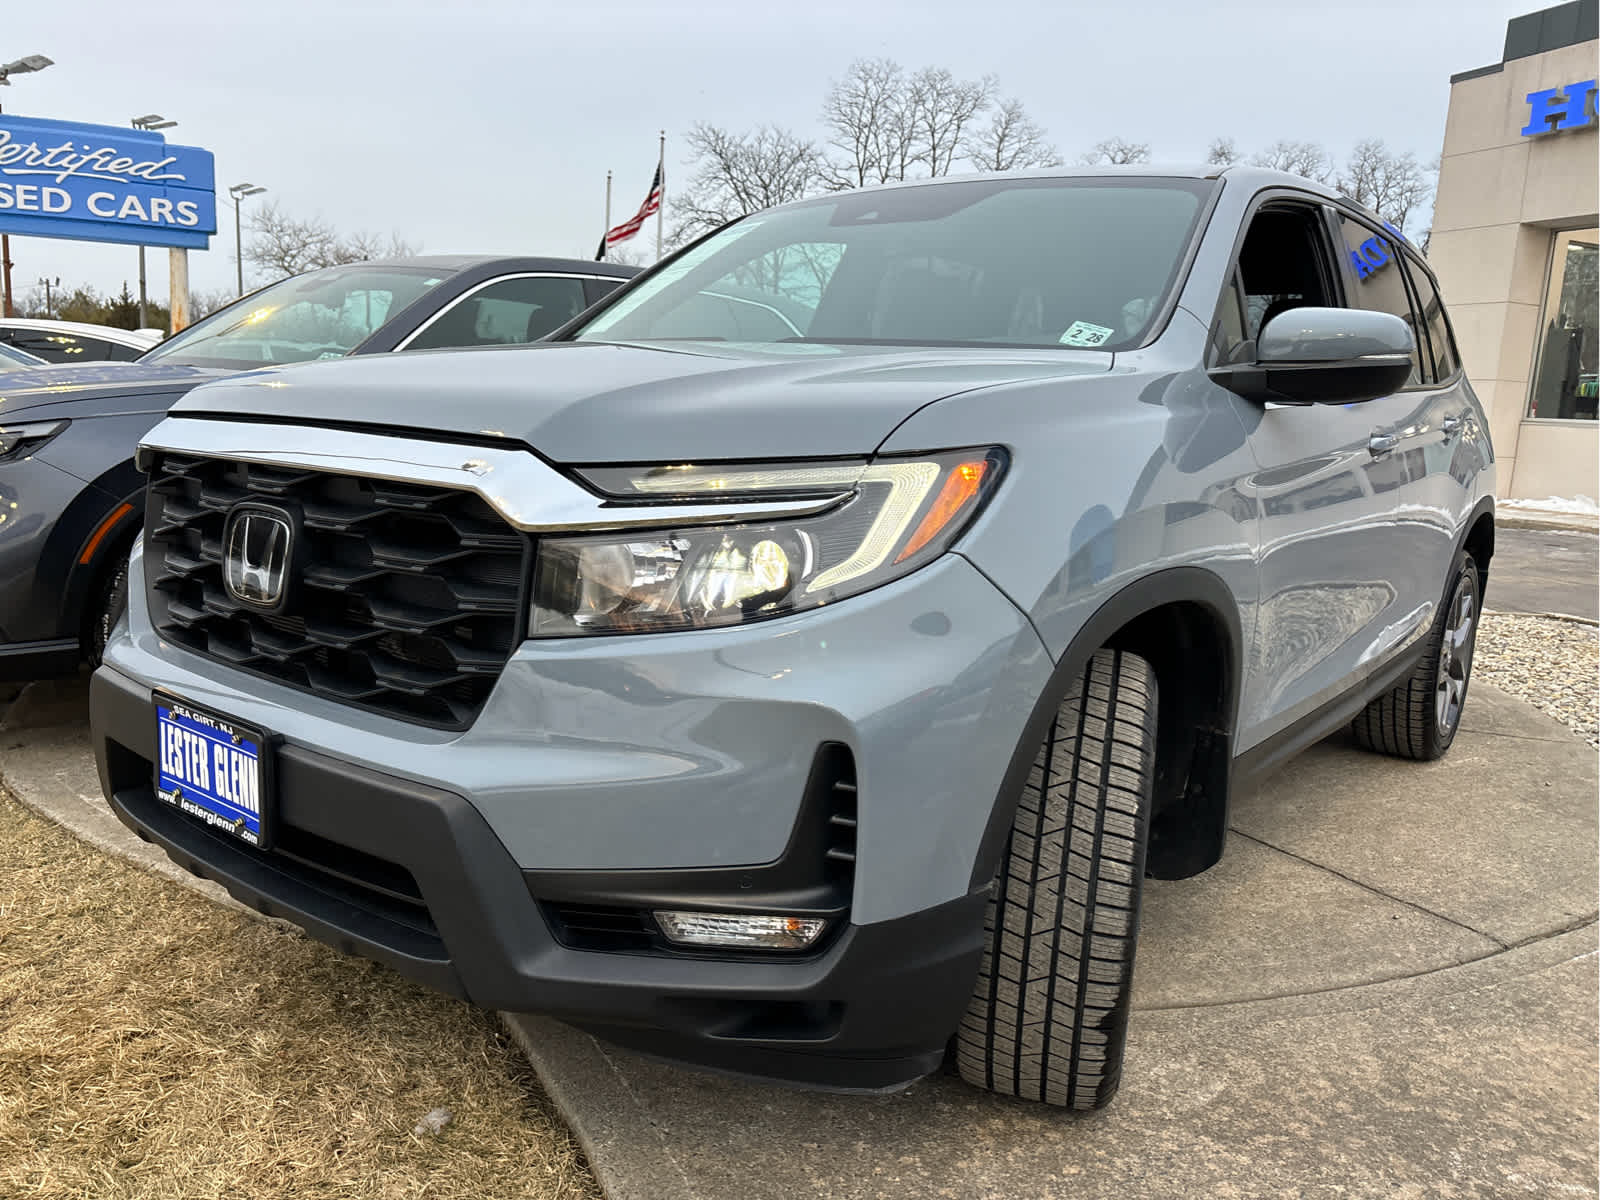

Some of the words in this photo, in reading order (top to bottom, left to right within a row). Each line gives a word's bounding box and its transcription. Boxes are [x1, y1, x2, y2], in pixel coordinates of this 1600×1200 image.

[1521, 79, 1599, 136] H
[87, 192, 199, 227] CARS
[1070, 329, 1083, 338] 2
[1085, 333, 1104, 344] 28
[173, 704, 192, 719] SEA
[219, 722, 233, 735] NJ
[160, 721, 210, 791] LESTER
[213, 743, 260, 815] GLENN
[180, 798, 236, 833] lesterglenn
